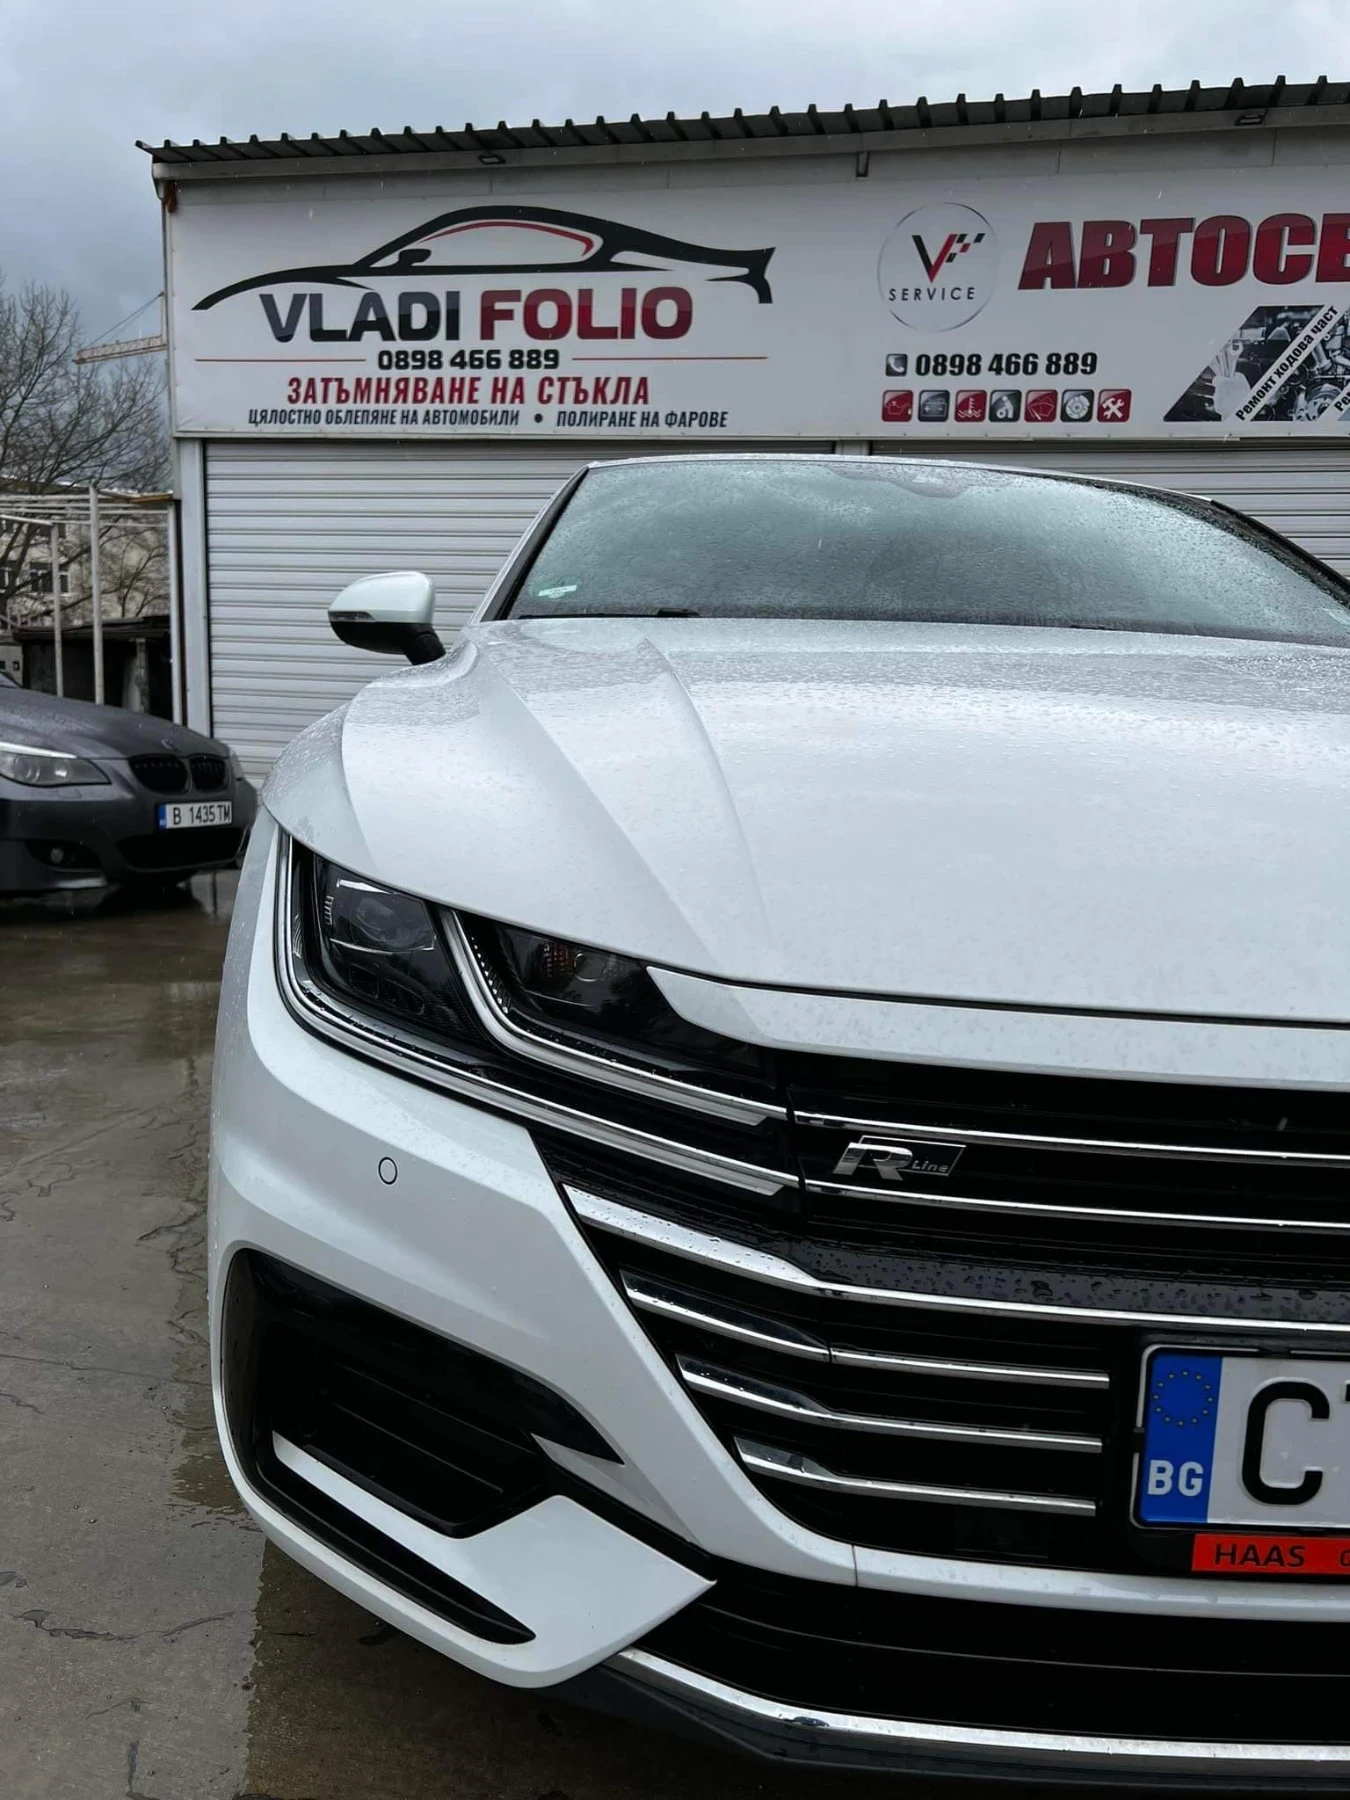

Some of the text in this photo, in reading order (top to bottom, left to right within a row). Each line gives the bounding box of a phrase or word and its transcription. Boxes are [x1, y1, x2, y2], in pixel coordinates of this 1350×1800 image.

[888, 286, 976, 302] SERVICE
[259, 286, 693, 343] VLADI FOLIO
[378, 348, 560, 371] 0898 466 889
[915, 352, 1098, 377] 0898 466 889
[287, 376, 650, 405] ЗАТЪМНЯВАНЕ НА СТЪКЛА
[248, 409, 520, 427] ЦЯЛОСТНО ОБЛЕПЯНЕ НА АВТОМОБИЛИ
[556, 410, 729, 428] ПОЛИРАНЕ НА ФАРОВЕ
[189, 805, 216, 824] 1435
[217, 803, 231, 822] TM
[1241, 1380, 1350, 1505] C
[1147, 1459, 1204, 1497] BG
[1214, 1543, 1306, 1568] HAAS
